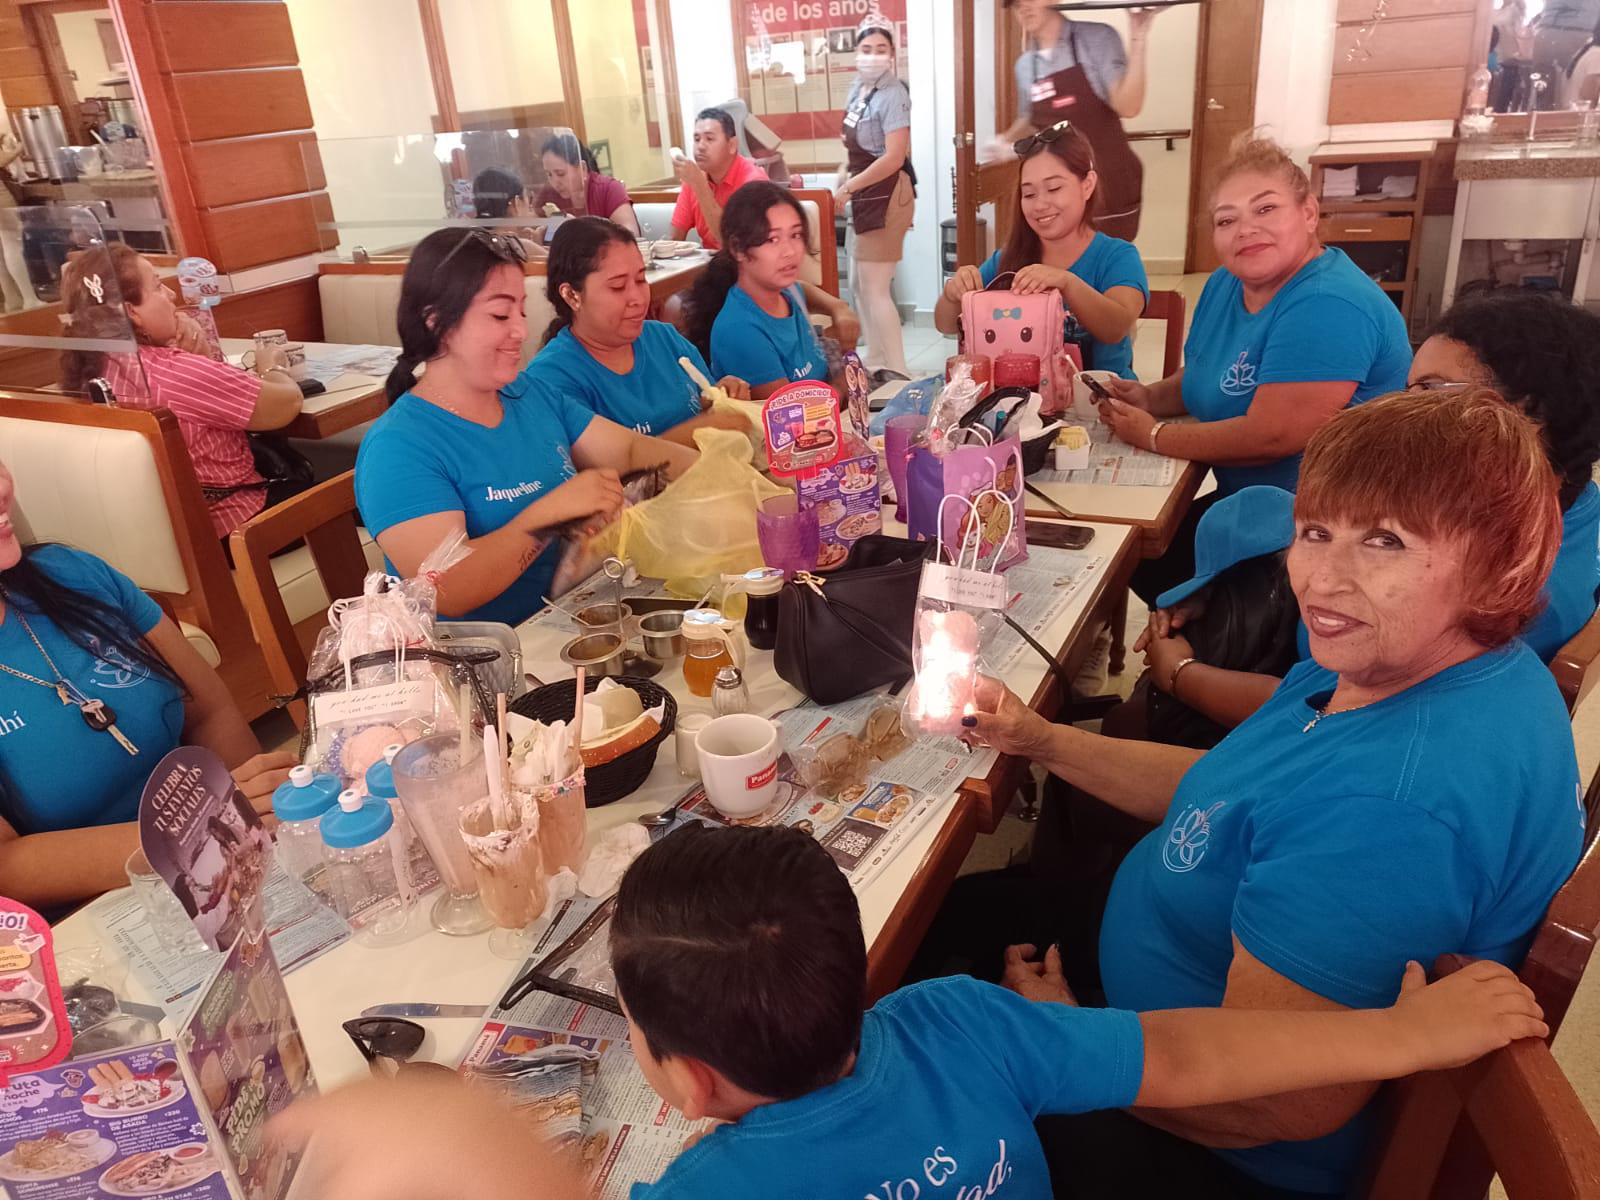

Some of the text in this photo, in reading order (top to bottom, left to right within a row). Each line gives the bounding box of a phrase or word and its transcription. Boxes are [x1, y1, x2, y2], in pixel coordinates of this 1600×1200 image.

[762, 3, 788, 23] de
[793, 1, 823, 20] los
[485, 480, 544, 502] Jaqueline
[152, 763, 188, 810] CELEBRA
[167, 764, 203, 813] EVENTOS
[169, 784, 206, 837] SOCIALES
[226, 1084, 252, 1136] PIDE
[232, 1083, 266, 1154] PROMO
[923, 1146, 958, 1187] es
